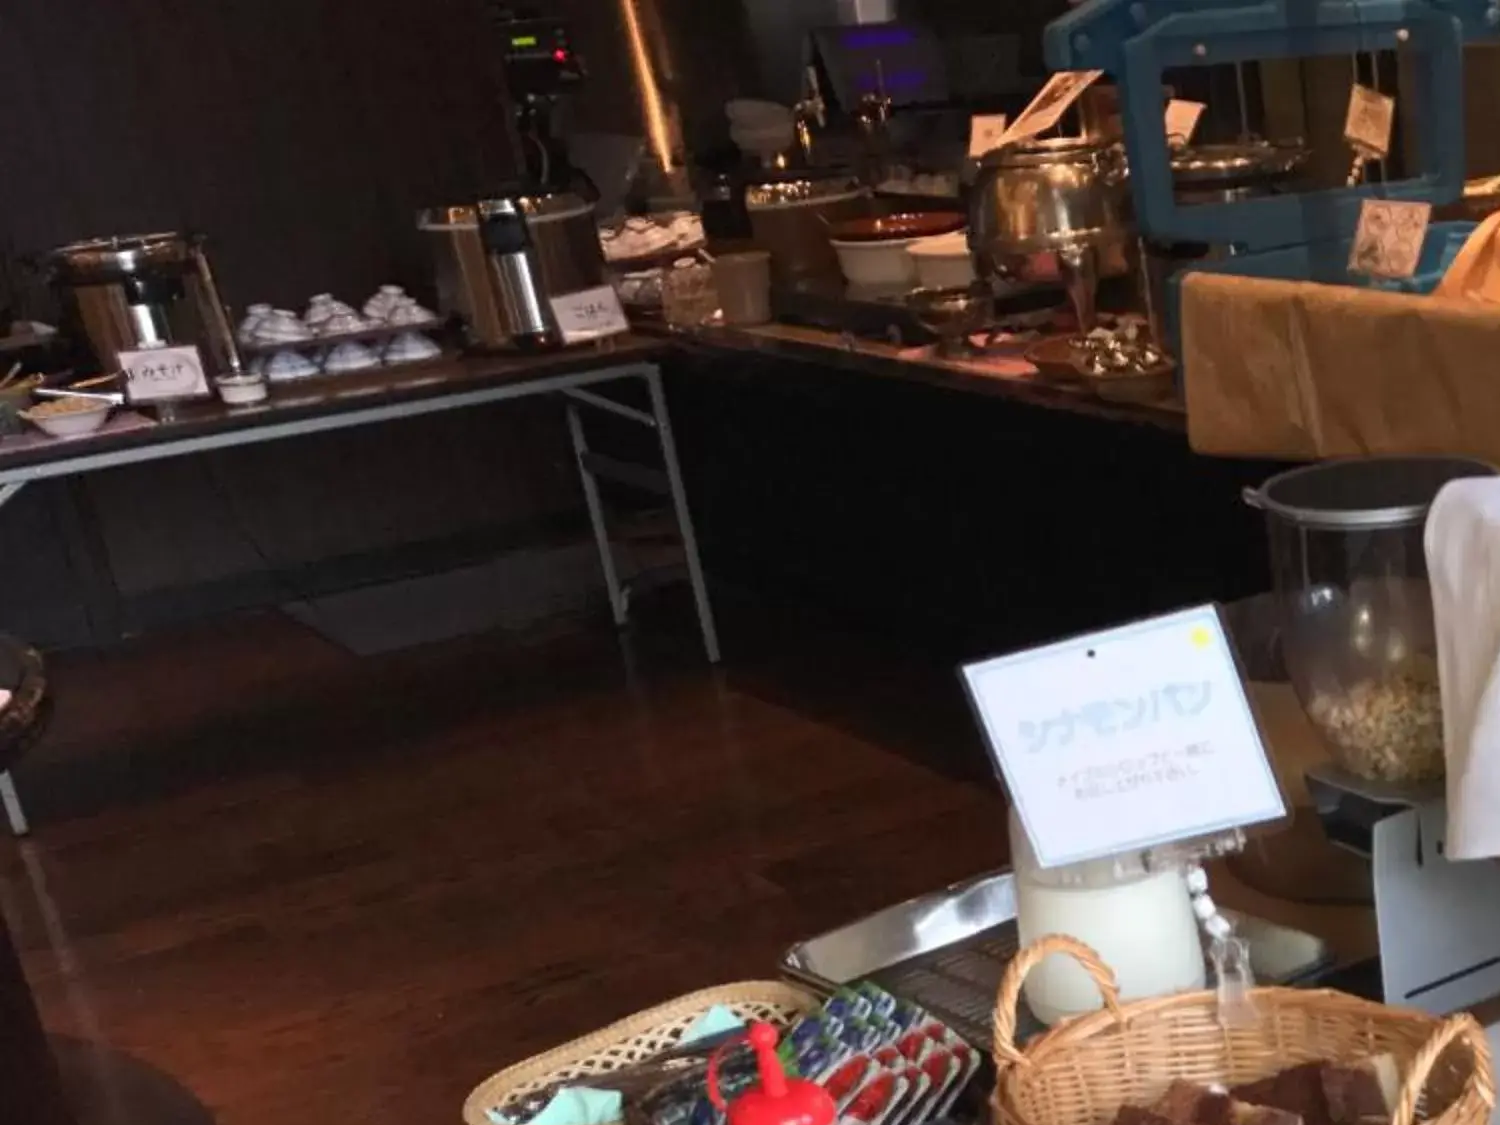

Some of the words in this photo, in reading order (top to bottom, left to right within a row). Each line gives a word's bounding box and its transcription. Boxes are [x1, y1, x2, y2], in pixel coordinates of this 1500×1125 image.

[1017, 680, 1212, 754] シナモンパン
